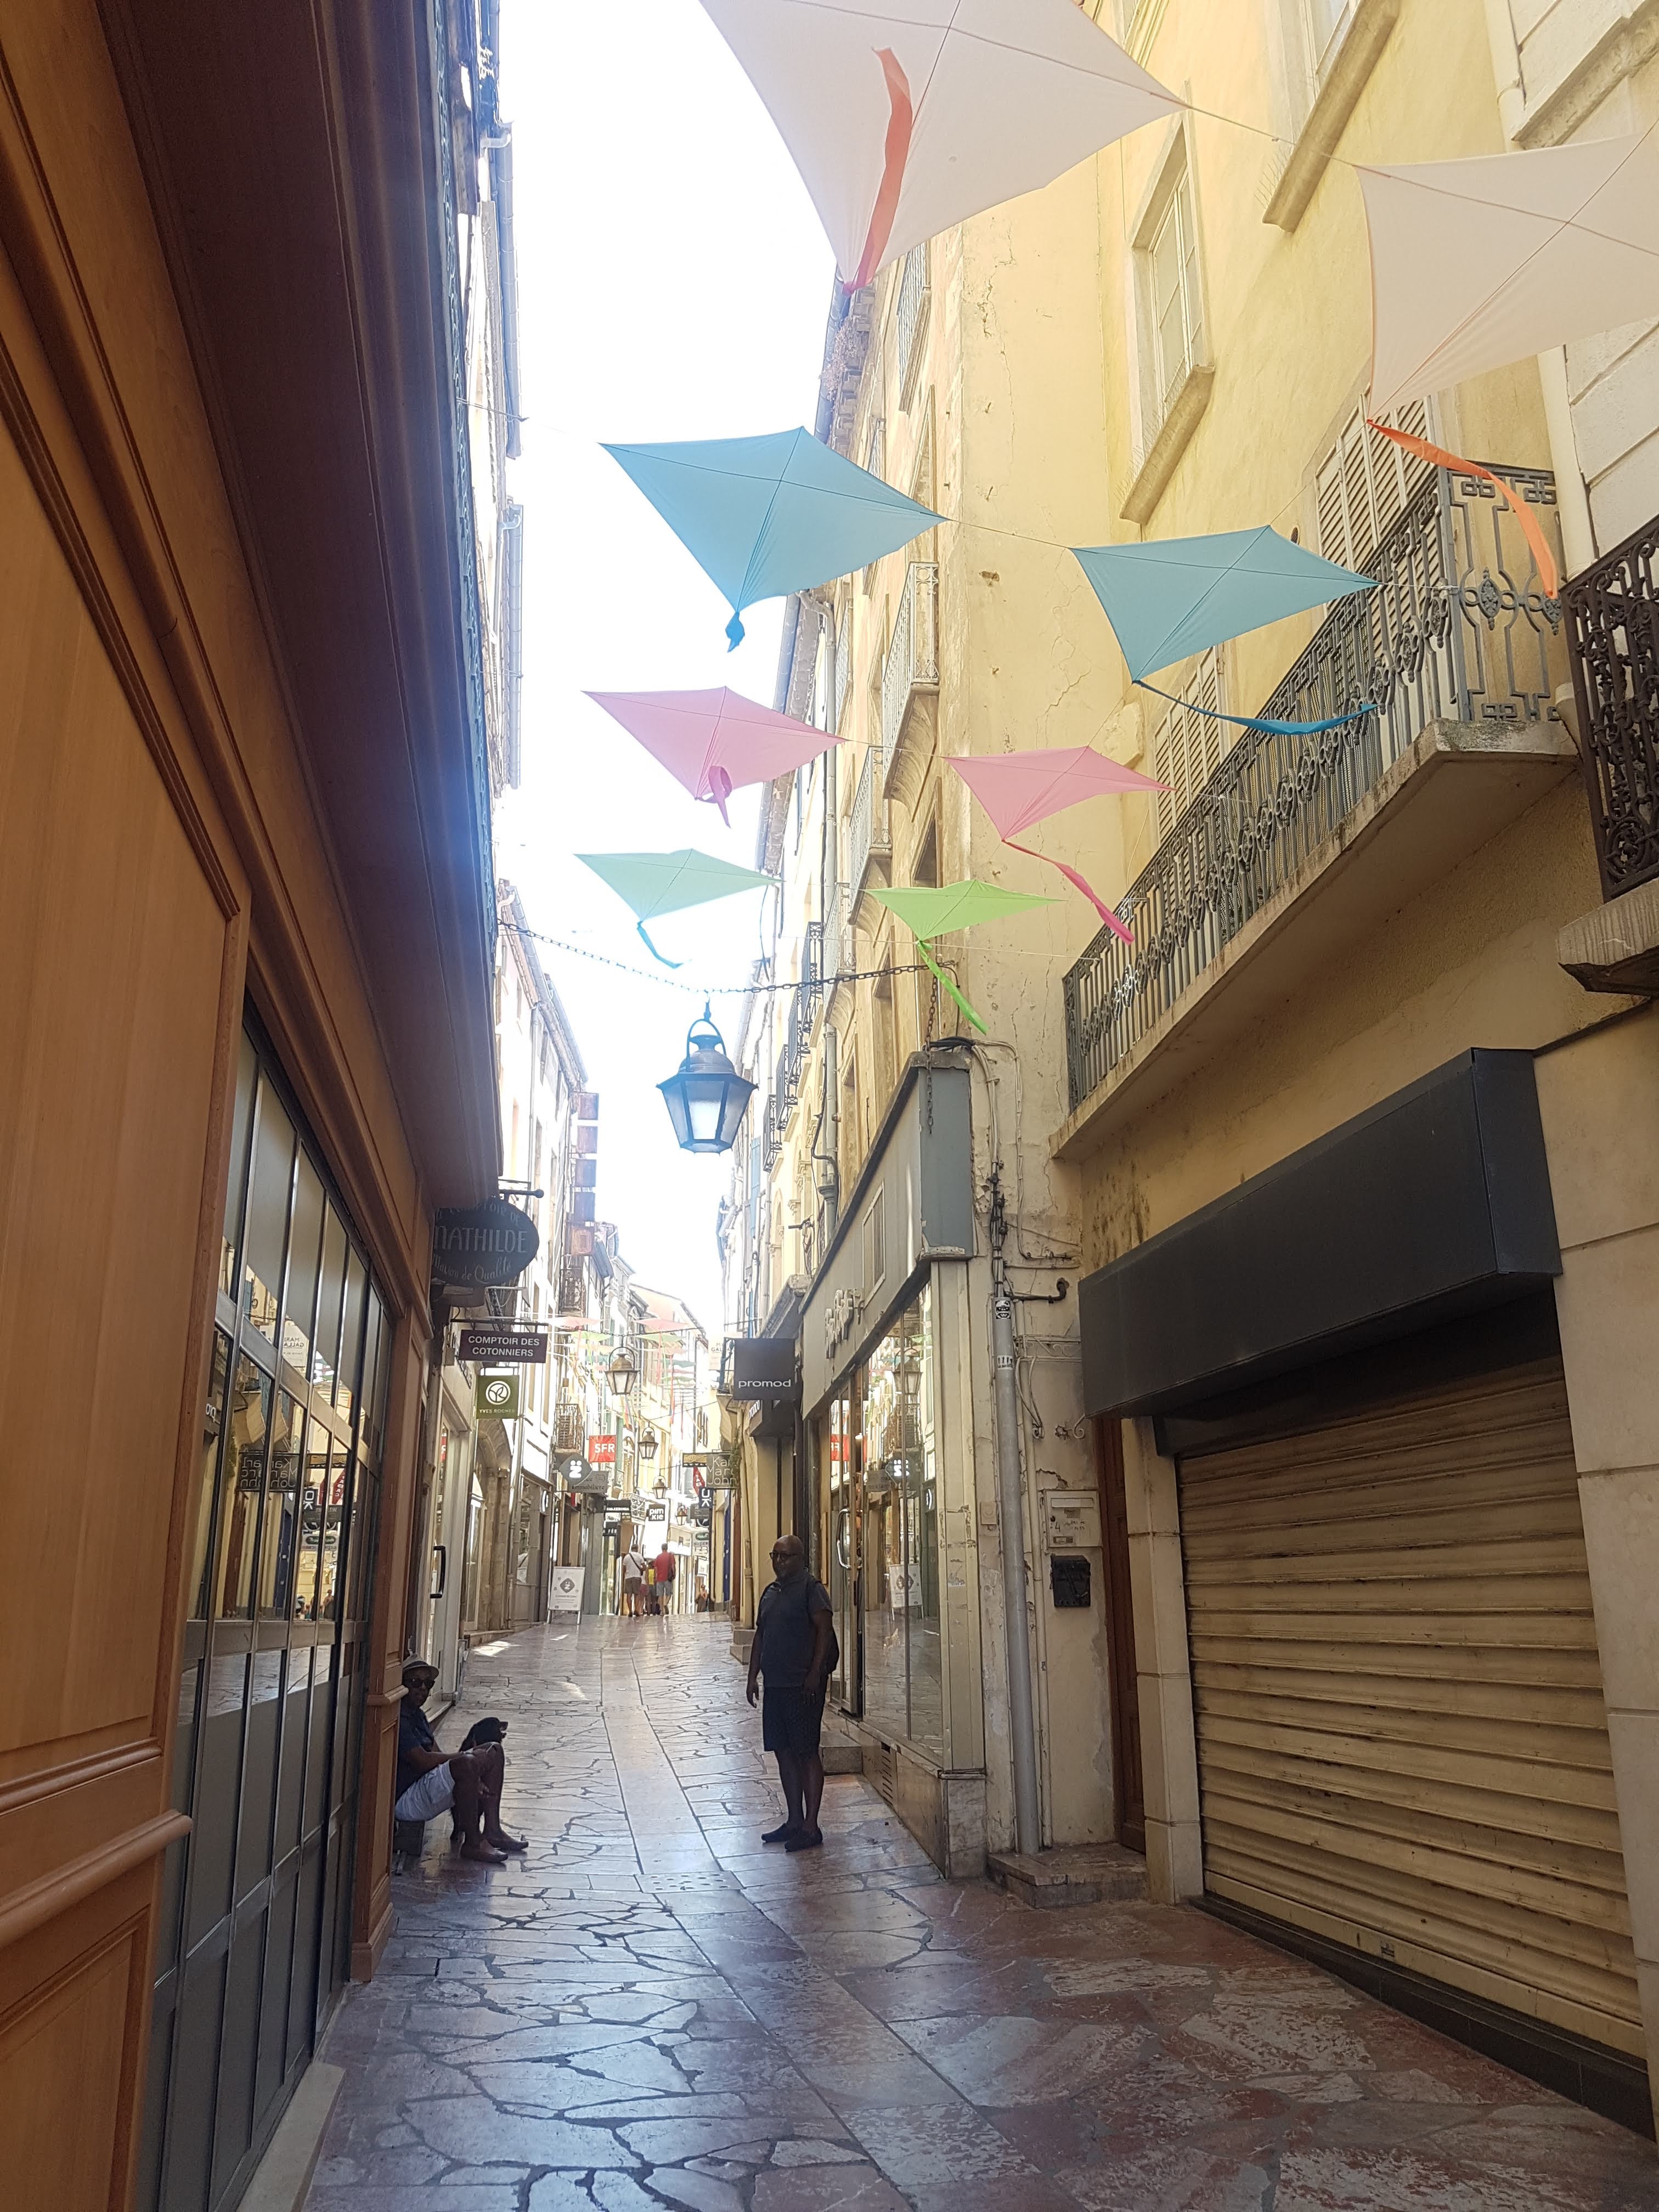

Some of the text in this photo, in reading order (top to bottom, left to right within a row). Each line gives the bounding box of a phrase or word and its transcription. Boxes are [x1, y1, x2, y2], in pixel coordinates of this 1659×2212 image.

[468, 1336, 518, 1345] COMPTOIR
[472, 1347, 534, 1357] COTONNIERS
[738, 1379, 791, 1389] promod
[594, 1443, 615, 1453] SFR
